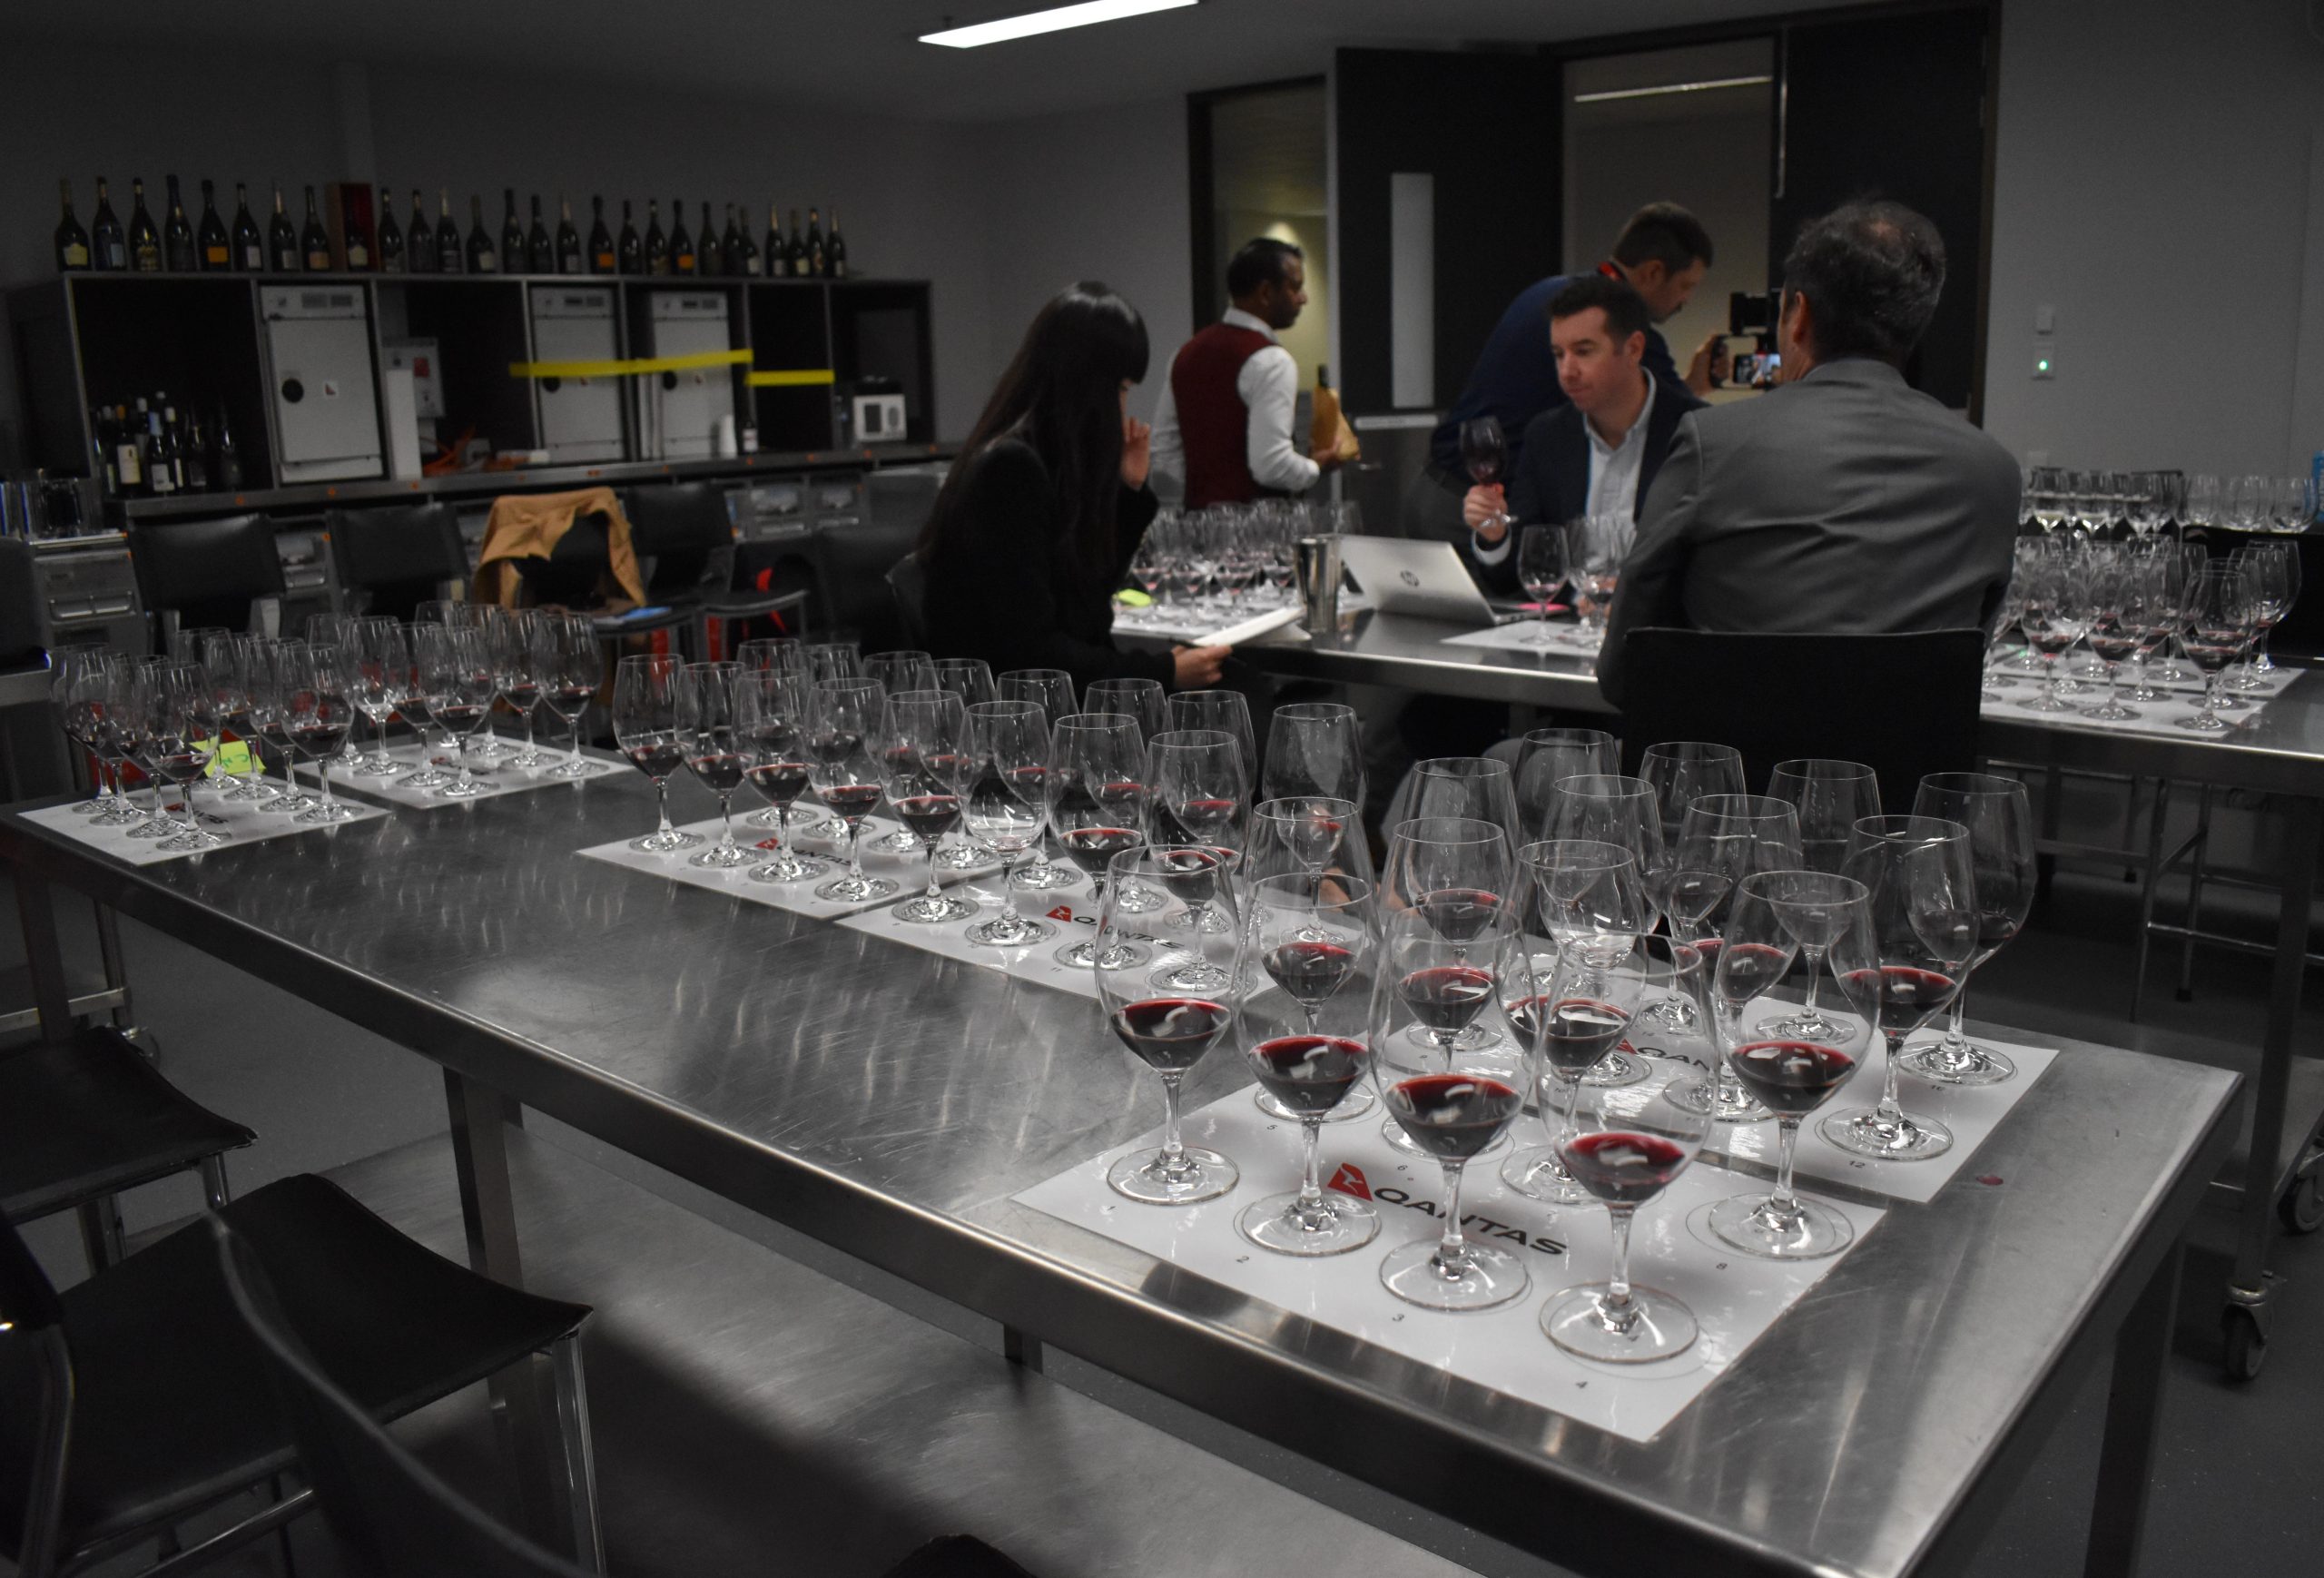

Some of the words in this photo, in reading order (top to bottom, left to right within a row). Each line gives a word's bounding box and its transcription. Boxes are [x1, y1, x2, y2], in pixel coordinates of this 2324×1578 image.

[1074, 916, 1184, 949] QNTAS
[1849, 1160, 1866, 1169] 12
[1374, 1188, 1567, 1255] QANTAS
[1236, 1256, 1249, 1264] 2
[1392, 1313, 1404, 1322] 3
[1575, 1381, 1588, 1389] 4
